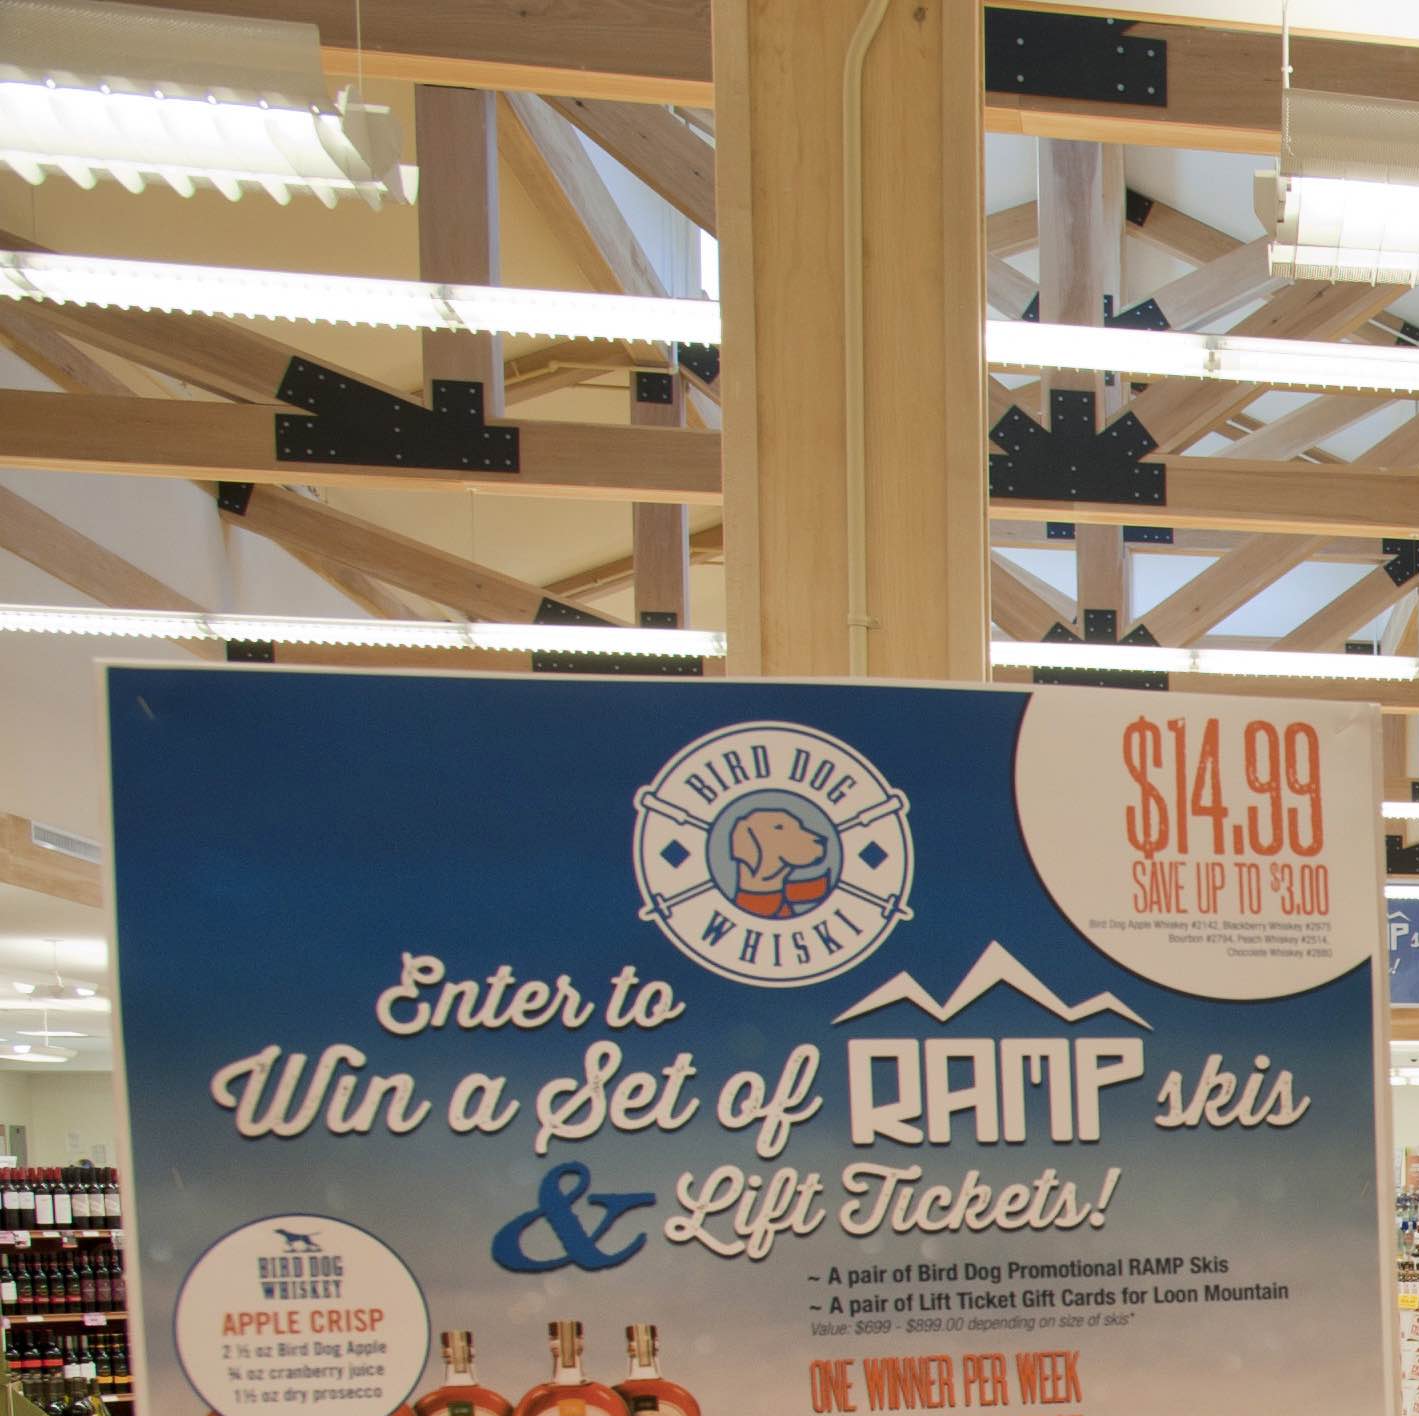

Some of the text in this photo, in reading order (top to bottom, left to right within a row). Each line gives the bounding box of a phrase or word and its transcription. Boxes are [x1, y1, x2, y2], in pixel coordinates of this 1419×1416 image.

[684, 744, 859, 806] BIRD DOG
[1122, 715, 1325, 860] $14.99
[1132, 861, 1330, 916] SAVE UP TO $3.00
[700, 908, 864, 968] WHISKI
[375, 951, 687, 1035] Enter to
[209, 1035, 1312, 1159] Win a Set of RAMP skis
[491, 1161, 1123, 1274] & Lift Tickets!
[258, 1256, 344, 1279] BIRD DOG
[261, 1280, 343, 1300] WHISKEY
[827, 1255, 1229, 1288] A pair of Bird Dog Promotional RAMP Skis
[222, 1308, 385, 1336] APPLE CRISP
[829, 1281, 1289, 1319] A pair of Lift Ticket Gift Cards for Loon Mountain
[855, 1320, 891, 1335] $699
[906, 1317, 964, 1333] $899.00
[968, 1316, 1035, 1332] depending
[1039, 1317, 1055, 1328] on
[1058, 1314, 1084, 1328] size
[1087, 1314, 1102, 1327] of
[810, 1350, 1083, 1414] ONE WINNER PER WEEK
